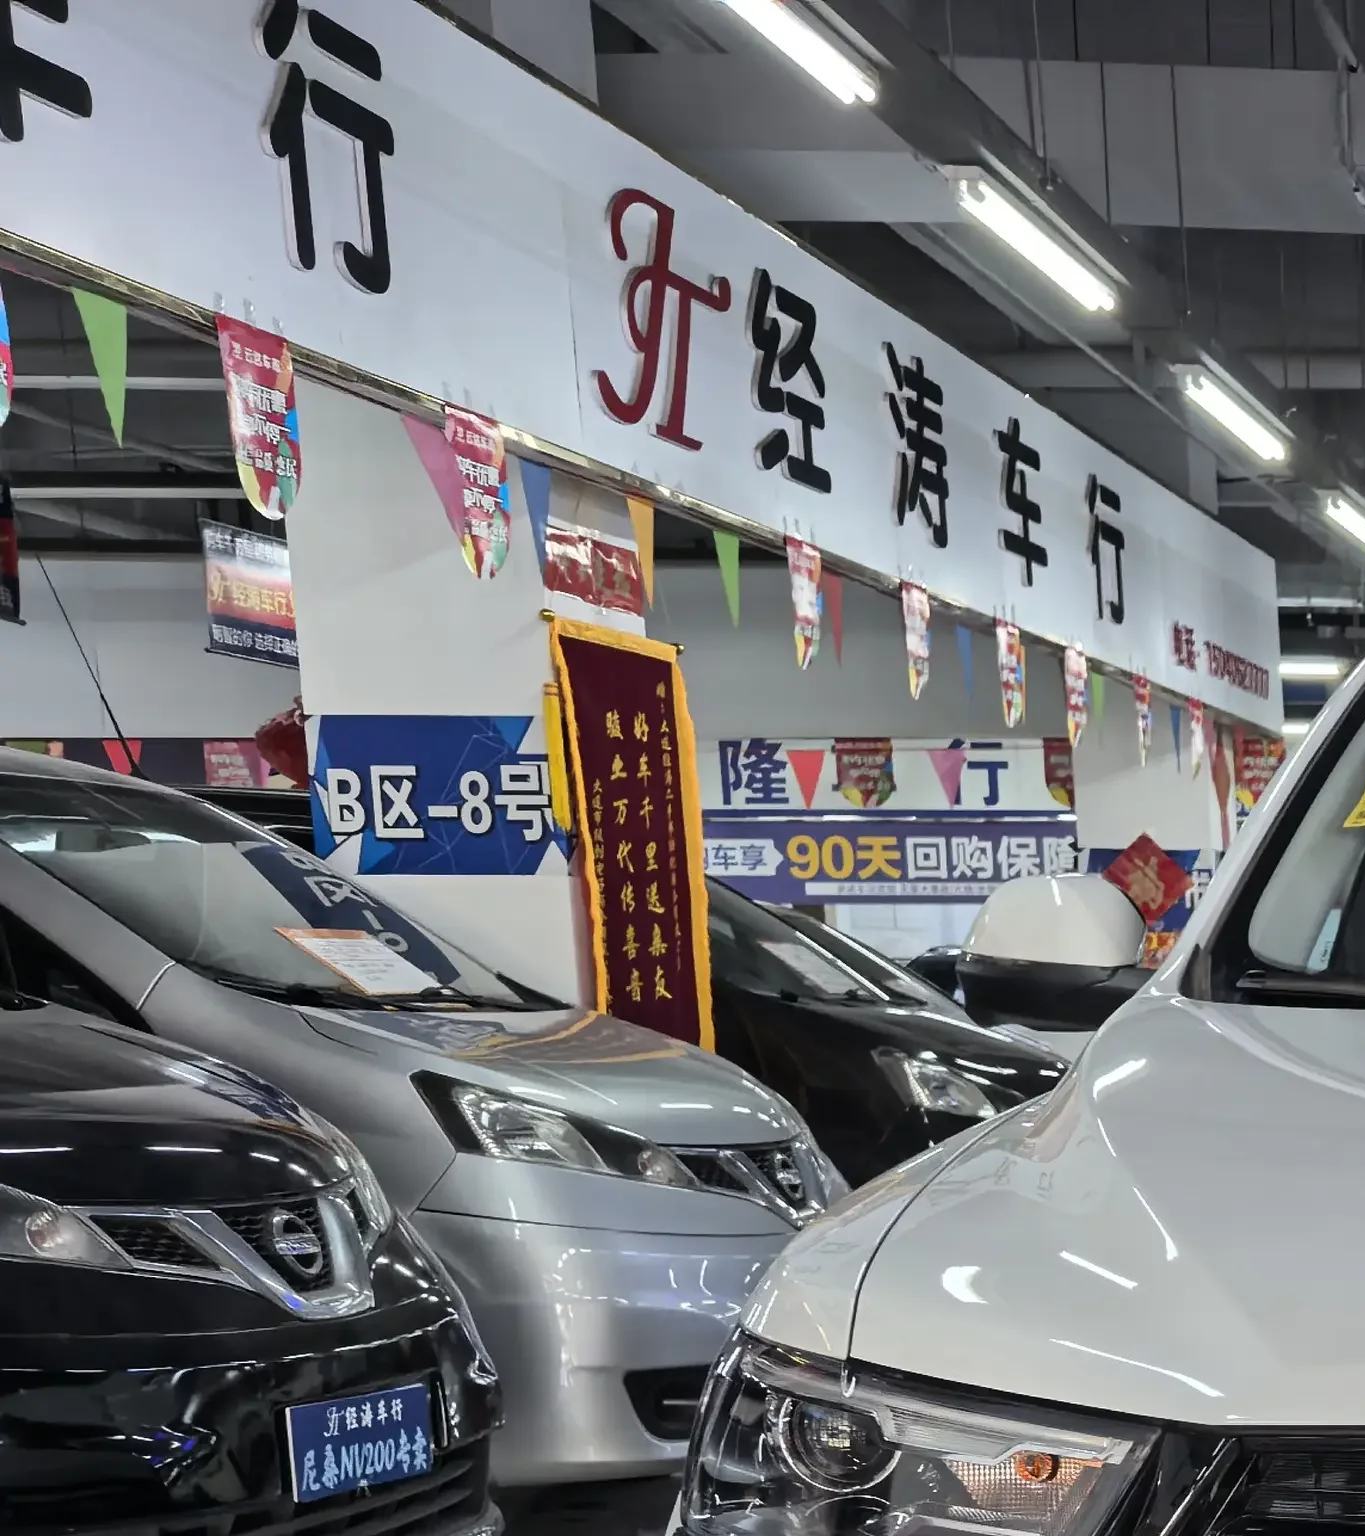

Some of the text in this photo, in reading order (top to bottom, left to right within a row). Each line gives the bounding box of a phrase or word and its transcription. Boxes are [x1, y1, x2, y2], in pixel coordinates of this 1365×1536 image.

[747, 267, 1125, 624] 经涛车行
[326, 764, 556, 842] B区-8号
